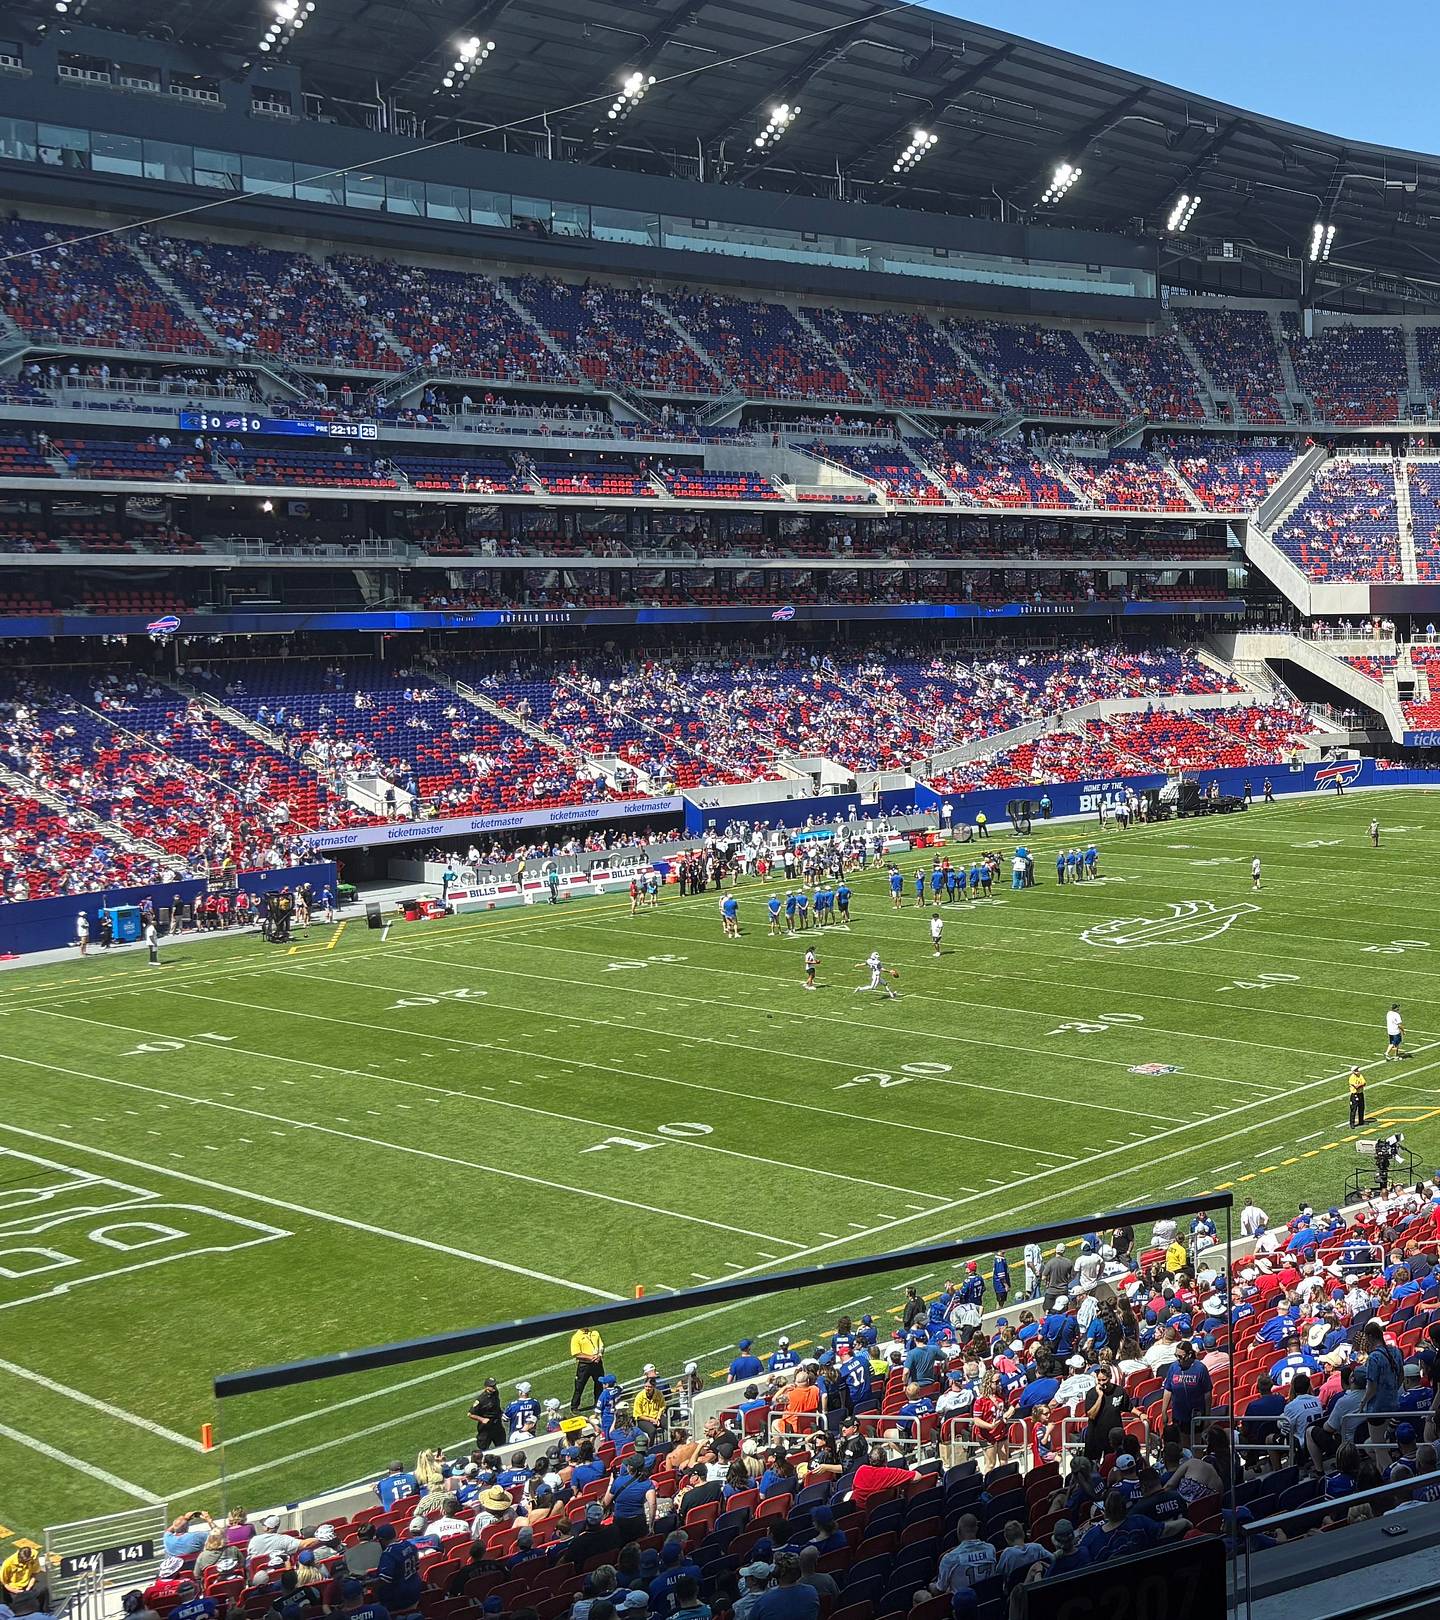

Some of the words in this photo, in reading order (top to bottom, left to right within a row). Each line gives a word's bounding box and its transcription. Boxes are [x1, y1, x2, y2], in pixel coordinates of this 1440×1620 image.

[211, 417, 221, 428] 0
[252, 419, 261, 430] 0
[315, 425, 328, 433] PRE
[330, 424, 358, 436] 22:13
[362, 427, 375, 437] 25
[1083, 782, 1101, 793] HOME
[1102, 782, 1111, 791] OF
[1111, 781, 1124, 790] THE
[623, 800, 672, 814] ticketmaster
[471, 815, 524, 830] ticketmaster
[550, 808, 600, 822] ticketmaster
[388, 824, 444, 839] ticketmaster
[612, 868, 636, 879] BILLS
[470, 887, 497, 898] BILLS
[1361, 939, 1432, 955] 50
[1058, 1012, 1144, 1033] 30
[852, 1061, 953, 1089] 20
[596, 1121, 714, 1153] 10
[850, 1366, 864, 1387] 17
[1155, 1500, 1179, 1515] SPIKES
[117, 1544, 144, 1561] 141
[968, 1554, 988, 1562] ALLEN
[69, 1554, 99, 1572] 144
